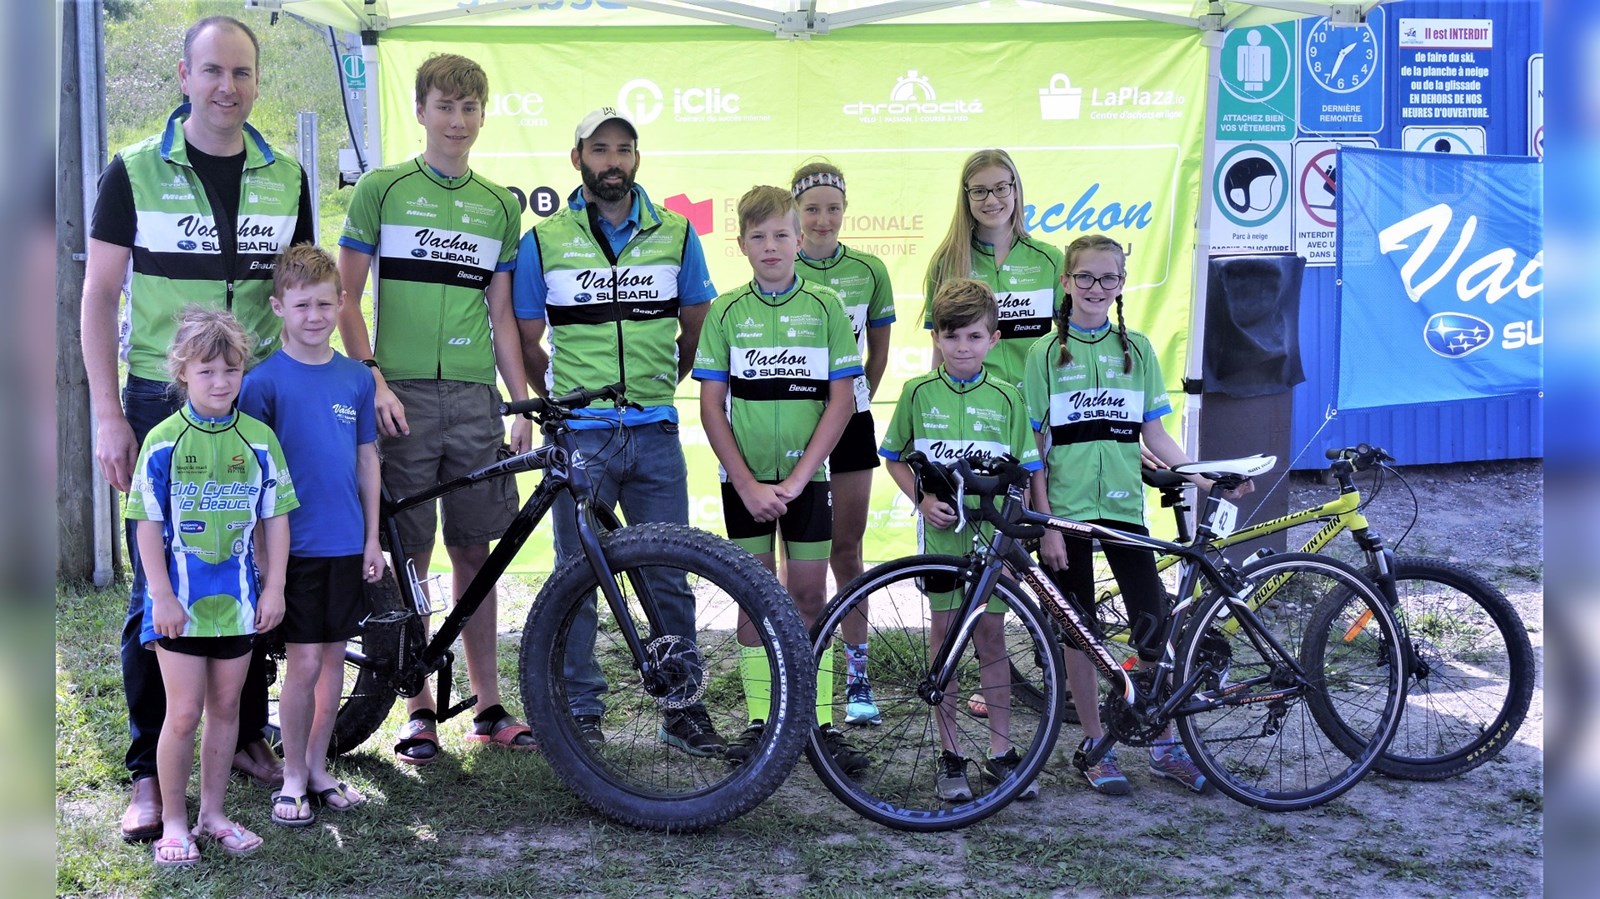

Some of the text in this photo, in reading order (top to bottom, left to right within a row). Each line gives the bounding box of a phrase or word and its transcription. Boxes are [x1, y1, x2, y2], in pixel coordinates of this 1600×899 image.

[1313, 32, 1327, 43] 10
[1362, 32, 1370, 43] 2
[1433, 28, 1448, 40] est
[1449, 28, 1489, 40] INTERDIT
[1310, 46, 1317, 57] 9
[1366, 49, 1373, 60] 3
[1415, 52, 1476, 64] de faire du ski,
[1314, 62, 1322, 72] 8
[1361, 64, 1368, 74] 4
[1401, 66, 1489, 78] de la planche à neige
[1324, 74, 1332, 84] 7
[1337, 78, 1344, 90] 6
[1352, 75, 1359, 85] 5
[1411, 80, 1481, 92] ou de la glissade
[673, 87, 740, 114] iClic
[1410, 94, 1482, 104] EN DEHORS DE NOS
[843, 98, 984, 115] chronocité
[1322, 104, 1361, 112] DERNIÈRE
[1402, 107, 1433, 118] HEURES
[1222, 114, 1284, 122] ATTACHEZ BIEN
[1320, 113, 1363, 122] REMONTÉE
[1220, 122, 1286, 132] VOS VÊTEMENTS
[1024, 183, 1152, 233] achon
[842, 214, 924, 232] TIONALE
[414, 228, 478, 253] Vachon
[1232, 232, 1245, 240] Parc
[1252, 233, 1268, 241] neige
[430, 250, 480, 266] SUBARU
[1378, 203, 1544, 305] Vac
[456, 270, 484, 282] Beauce
[576, 268, 654, 290] Vachon
[596, 290, 659, 302] SUBARU
[998, 292, 1032, 308] chon
[998, 309, 1036, 318] UBARU
[1014, 324, 1042, 332] Beauce
[745, 349, 808, 366] Vachon
[760, 368, 810, 377] SUBARU
[788, 384, 817, 392] Beauce
[1069, 390, 1126, 410] Vachon
[1084, 410, 1128, 420] SUBARU
[930, 441, 992, 460] Vachon
[202, 480, 259, 498] Cycliste
[1048, 518, 1093, 532] PRESTIGE
[1300, 514, 1341, 553] UNTAIN
[1467, 720, 1510, 762] MAXXIS
